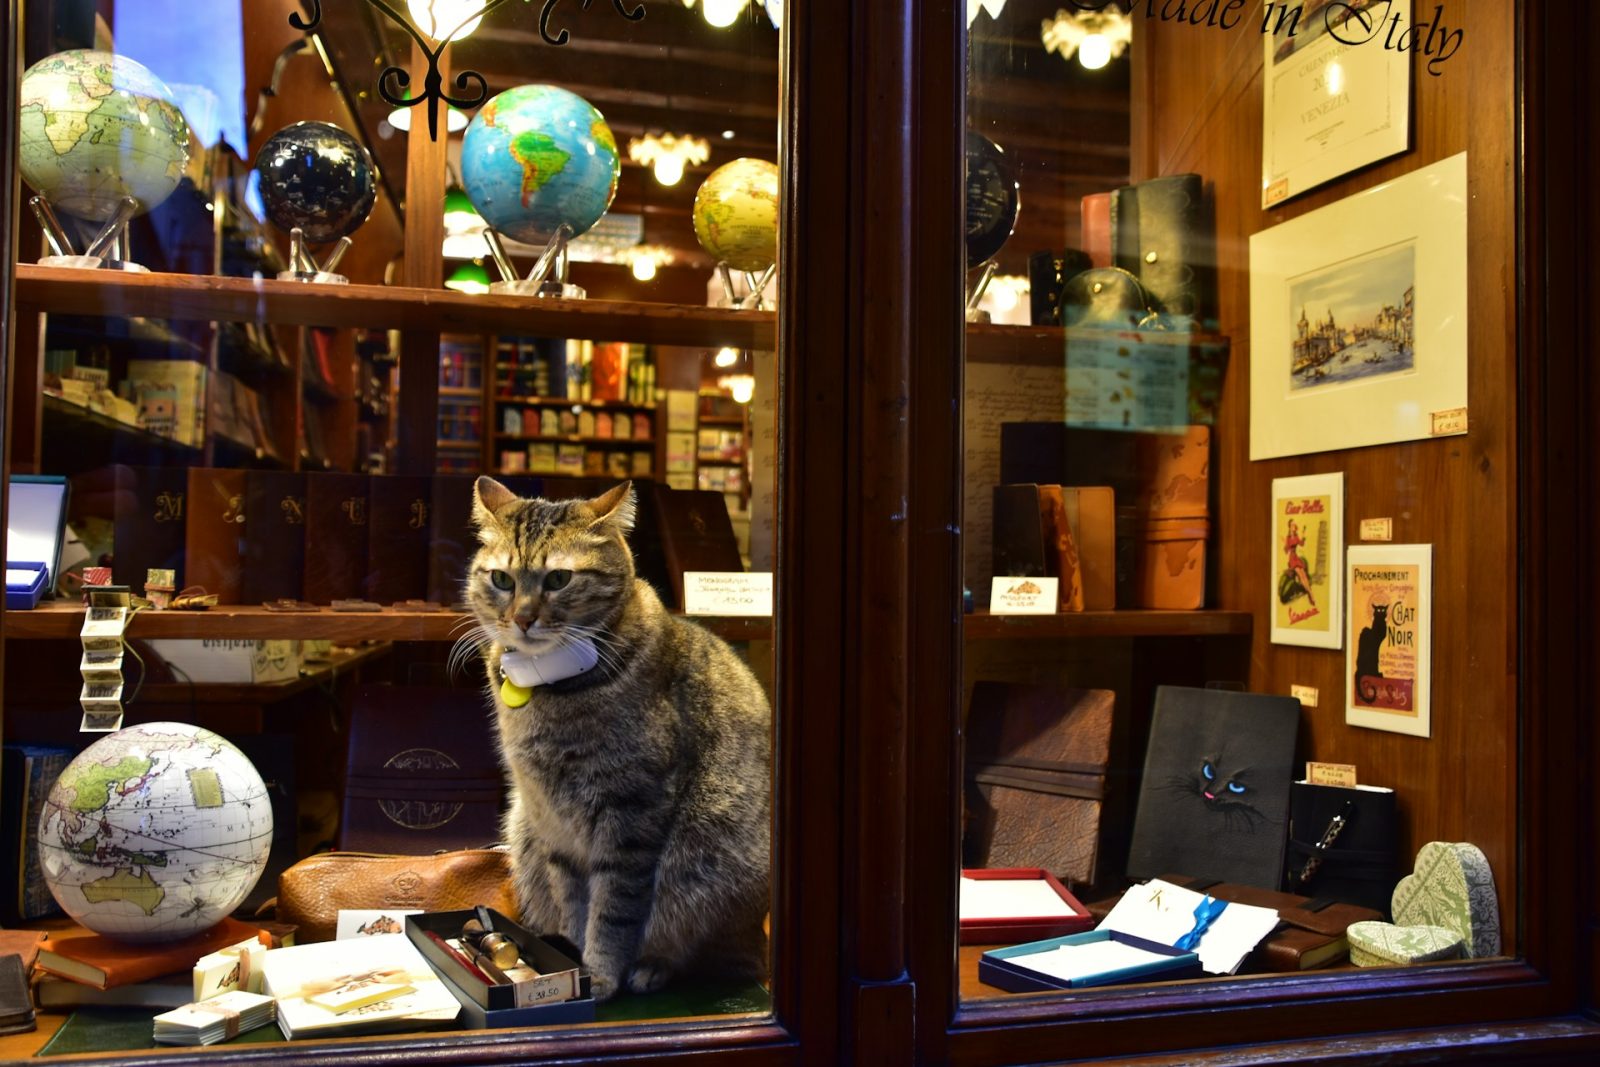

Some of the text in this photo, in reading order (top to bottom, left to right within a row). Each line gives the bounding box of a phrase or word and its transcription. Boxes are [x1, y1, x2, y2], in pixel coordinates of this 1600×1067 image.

[1260, 2, 1300, 37] in
[1324, 0, 1464, 76] Italy
[1299, 91, 1351, 125] VENEZIA
[1354, 568, 1409, 584] PROCHAINEMENT
[1391, 601, 1415, 626] CHAT
[1388, 626, 1414, 648] NOIR
